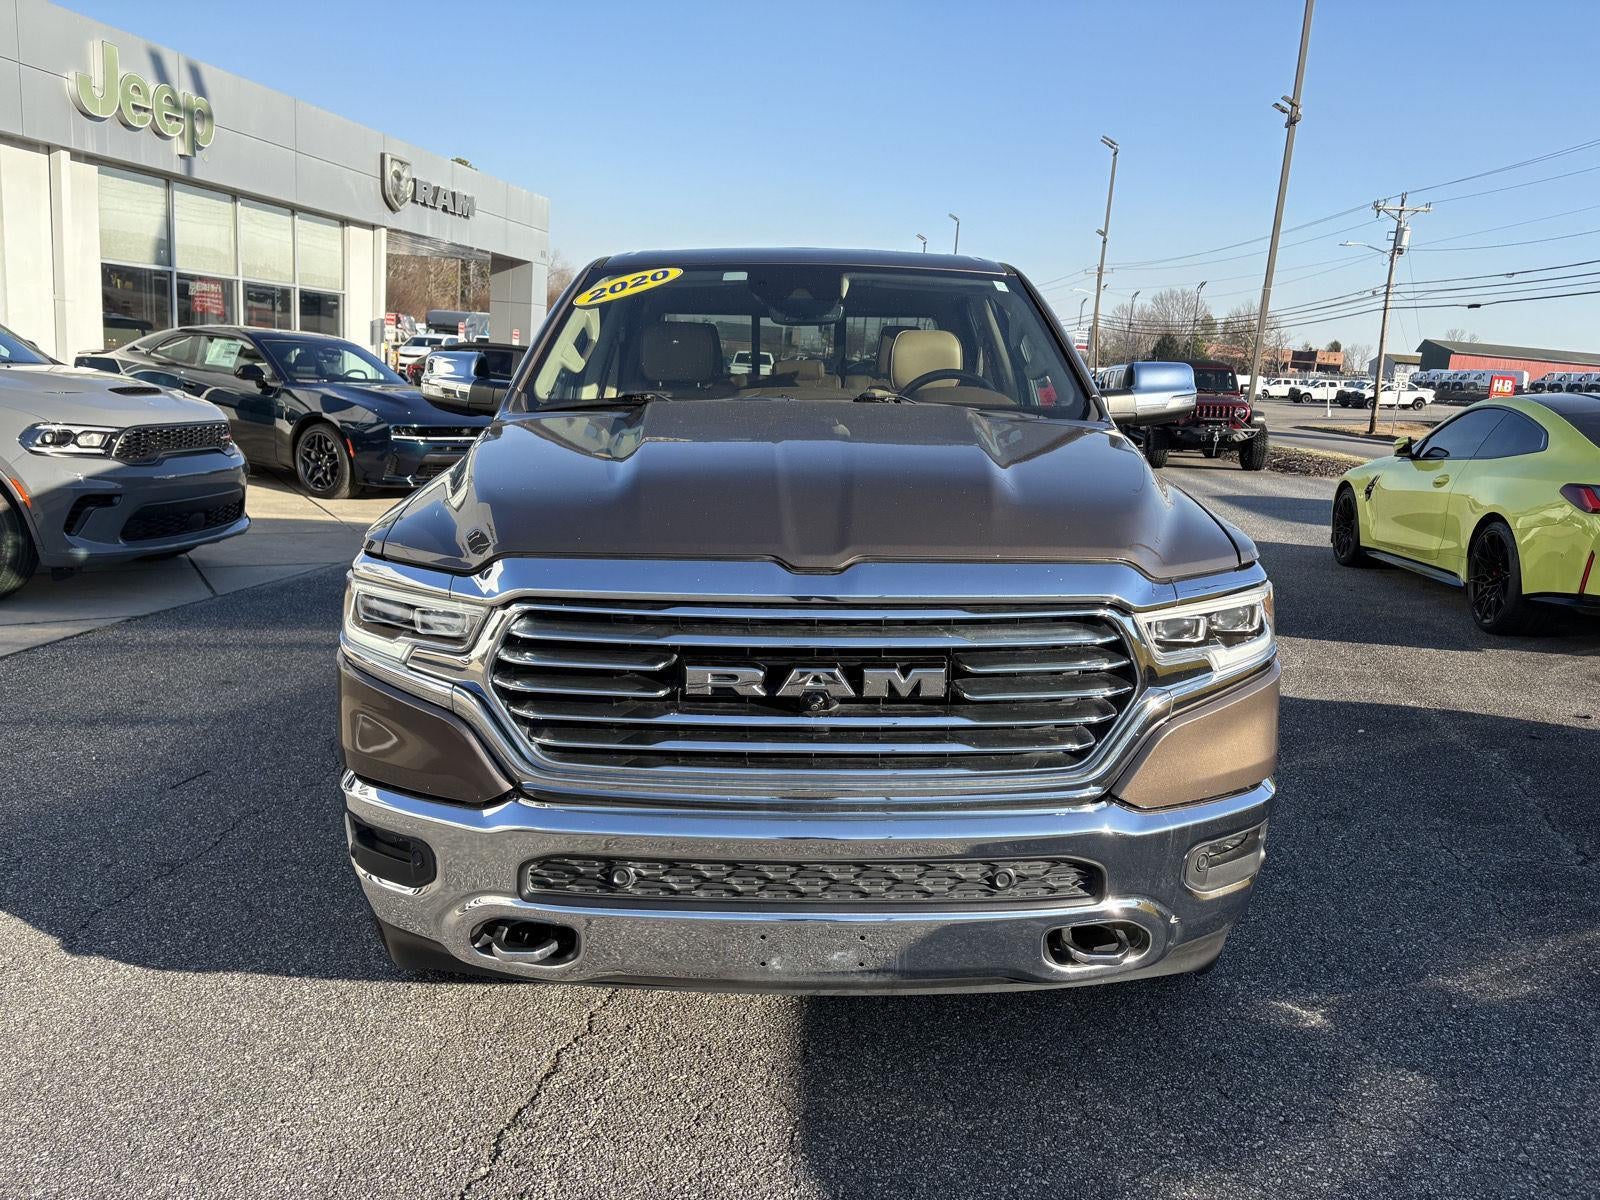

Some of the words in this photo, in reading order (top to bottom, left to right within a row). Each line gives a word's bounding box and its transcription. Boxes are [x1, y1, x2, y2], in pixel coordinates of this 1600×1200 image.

[69, 40, 215, 156] Jeep
[412, 178, 475, 217] RAM
[588, 270, 669, 302] 2020
[1394, 381, 1407, 389] 35
[686, 666, 946, 697] RAM
